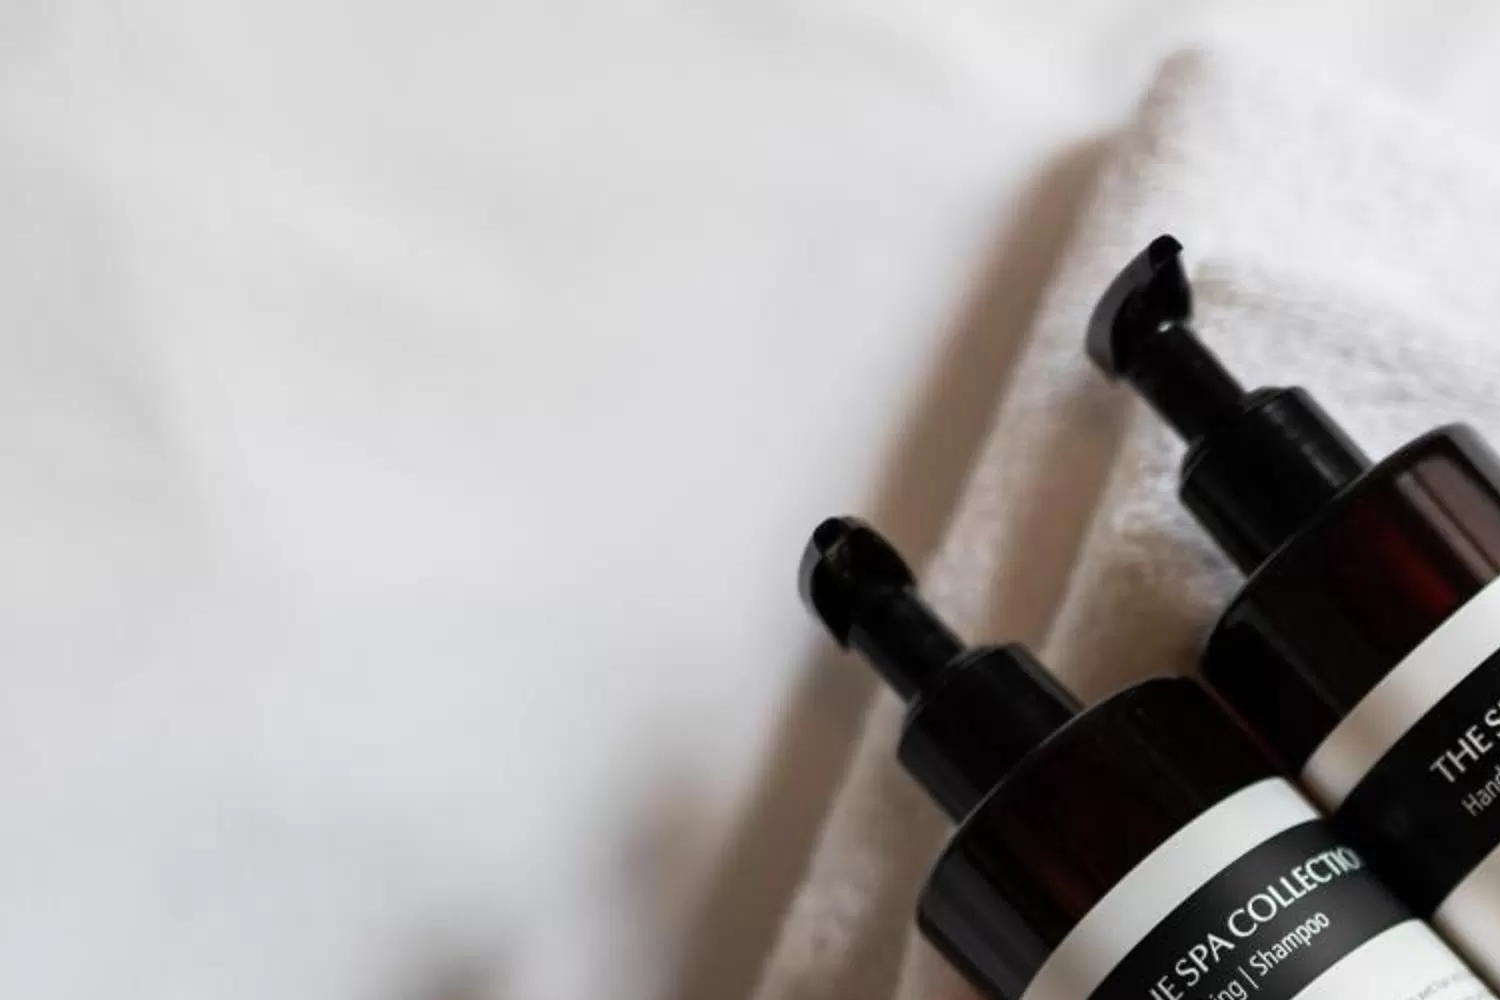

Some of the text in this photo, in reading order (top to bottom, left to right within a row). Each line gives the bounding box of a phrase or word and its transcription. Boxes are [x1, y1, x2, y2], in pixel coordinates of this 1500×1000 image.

[1429, 725, 1493, 783] THE
[1173, 932, 1235, 987] SPA
[1228, 847, 1362, 938] COLLECTIO
[1248, 910, 1331, 977] Shampoo
